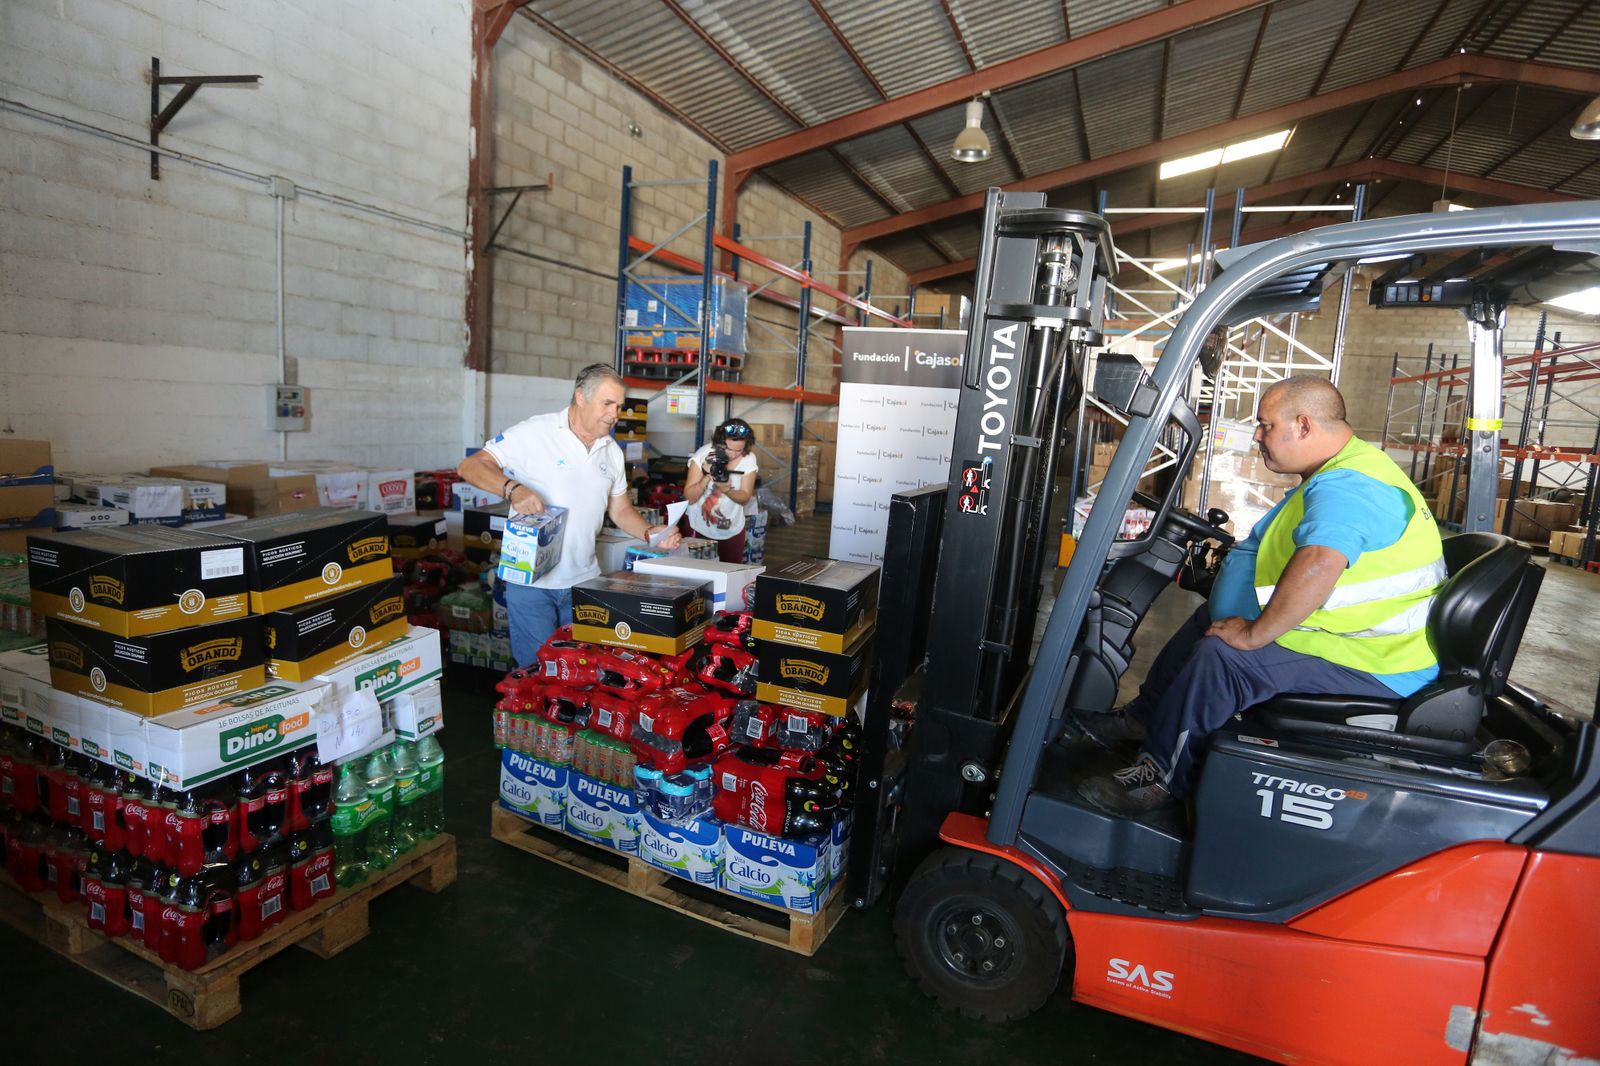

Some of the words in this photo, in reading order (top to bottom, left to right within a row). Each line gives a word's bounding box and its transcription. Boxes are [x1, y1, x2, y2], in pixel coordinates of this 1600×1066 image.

[853, 351, 900, 363] Fundación
[914, 350, 964, 369] Cajasol
[977, 323, 1019, 454] TOYOTA
[866, 423, 887, 432] Cajasol
[927, 428, 948, 436] Cajasol
[882, 451, 903, 459] Cajasol
[862, 475, 882, 484] Cajasol
[510, 522, 535, 534] PULEVA
[858, 525, 879, 535] Cajasol
[353, 543, 385, 560] OBANDO
[93, 582, 121, 600] OBANDO
[374, 602, 402, 621] OBANDO
[578, 609, 608, 621] OBANDO
[780, 602, 820, 617] OBANDO
[188, 647, 237, 668] OBANDO
[361, 658, 380, 672] BOLSAS
[386, 644, 414, 659] ACEITUNAS
[360, 670, 397, 691] Dino
[399, 660, 416, 677] food
[784, 664, 825, 681] OBANDO
[184, 688, 205, 698] PICOS
[218, 719, 228, 729] 16
[228, 711, 254, 727] BOLSAS
[254, 708, 263, 716] DE
[263, 697, 300, 715] ACEITUNAS
[250, 722, 269, 733] hiper
[281, 717, 304, 734] food
[418, 718, 435, 733] Dino
[53, 731, 69, 743] Dino
[226, 726, 277, 756] Dino
[83, 742, 99, 754] Dino
[116, 754, 132, 767] Dino
[509, 753, 557, 782] PULEVA
[502, 778, 531, 801] Calcio
[577, 778, 631, 808] PULEVA
[1251, 771, 1347, 801] TRAIGO
[570, 805, 604, 828] Calcio
[1256, 788, 1335, 830] 15
[643, 833, 678, 859] Calcio
[741, 831, 796, 857] PULEVA
[733, 855, 746, 865] Vita
[729, 861, 771, 884] Calcio
[751, 890, 771, 901] ENTERA
[1107, 957, 1175, 992] SAS
[1106, 976, 1125, 986] System
[1132, 984, 1149, 993] Active
[1150, 989, 1171, 1000] Stability
